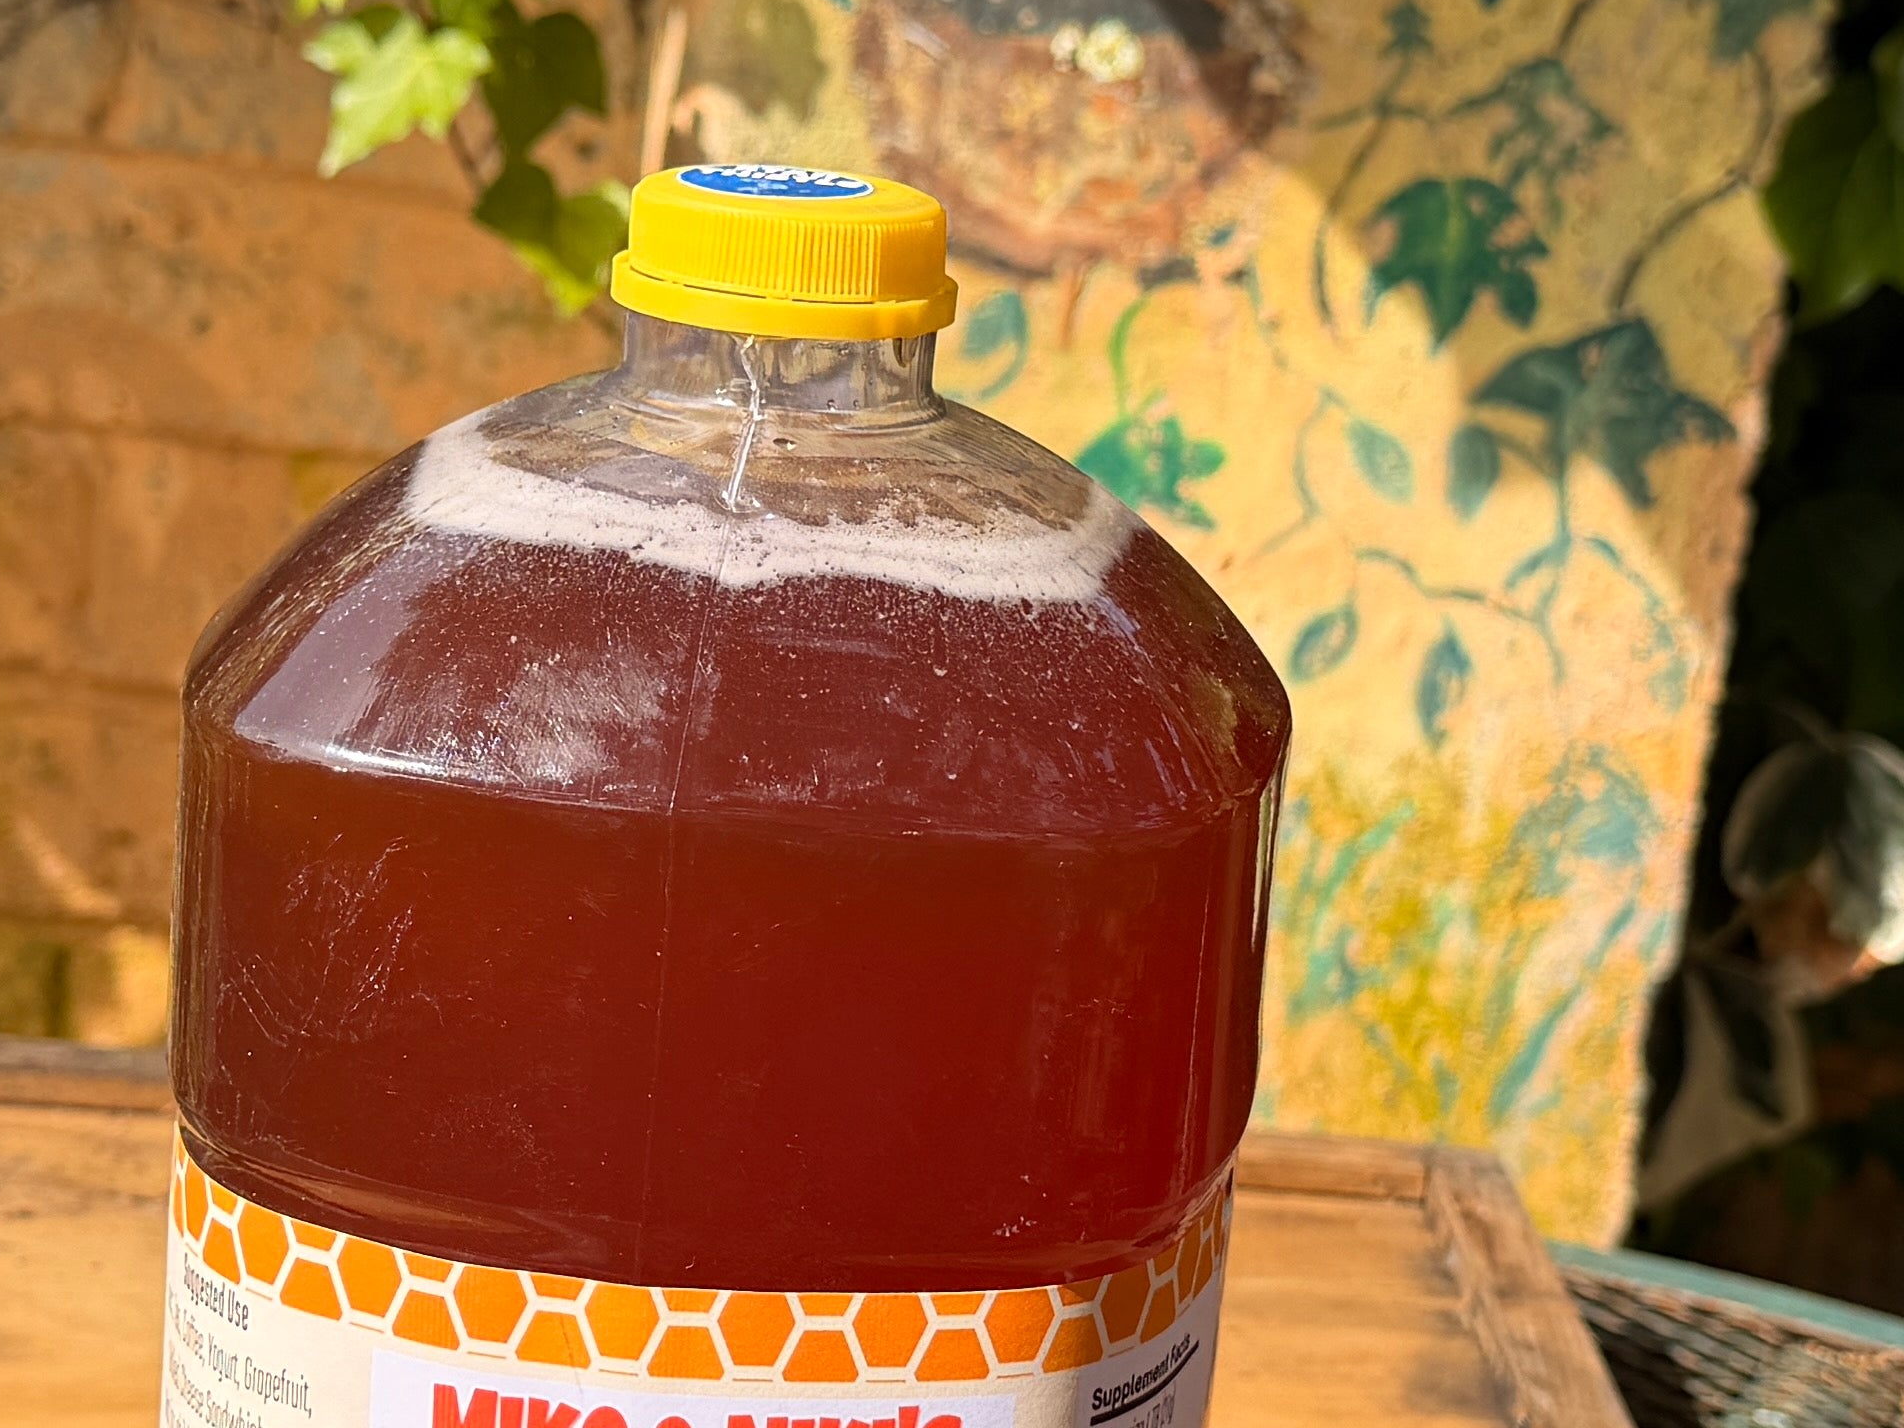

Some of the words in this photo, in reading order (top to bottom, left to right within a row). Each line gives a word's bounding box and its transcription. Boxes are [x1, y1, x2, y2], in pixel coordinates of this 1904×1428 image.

[228, 1287, 249, 1331] Use
[244, 1356, 312, 1419] Grapefruit,
[1092, 1353, 1169, 1410] Supplement
